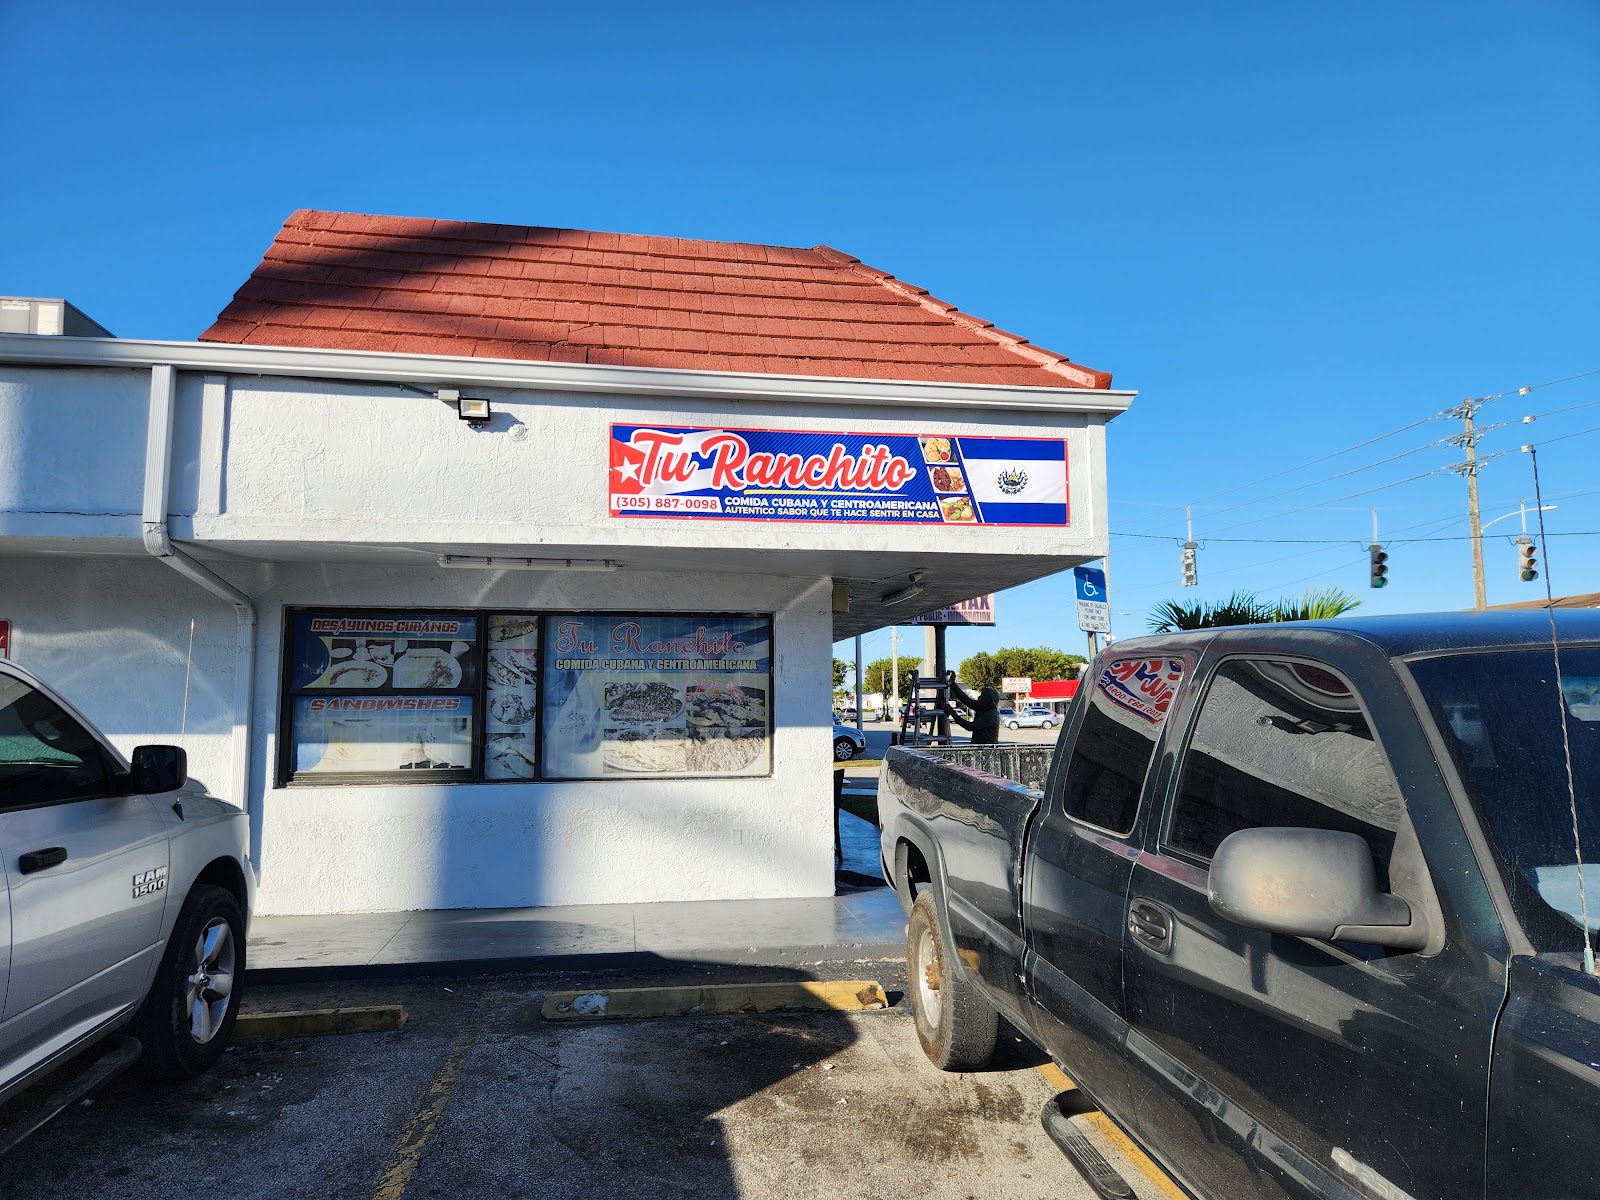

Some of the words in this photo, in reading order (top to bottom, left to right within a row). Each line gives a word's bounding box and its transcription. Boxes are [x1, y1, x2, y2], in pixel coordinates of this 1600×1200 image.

[631, 430, 697, 485] Tu
[700, 432, 915, 490] Ranchito
[616, 496, 651, 509] (305)
[655, 498, 718, 509] 887-0098
[724, 497, 768, 507] COMIDA
[772, 498, 818, 508] CUBANA
[821, 499, 829, 508] Y
[831, 499, 938, 511] CENTROAMERICANA
[724, 506, 775, 515] AUTENTICO
[777, 507, 808, 516] SABOR
[810, 509, 829, 517] QUE
[831, 509, 842, 517] TE
[869, 510, 901, 518] SENTIR
[916, 511, 940, 519] CASA
[554, 622, 599, 654] Tu
[612, 622, 748, 654] Ranchito
[555, 659, 599, 670] COMIDA
[602, 659, 645, 670] CUBANA
[647, 659, 655, 670] Y
[656, 659, 757, 670] CENTROAMERICANA
[310, 696, 460, 713] SANDWISHES
[133, 865, 167, 887] RAM
[132, 879, 166, 899] 1500
